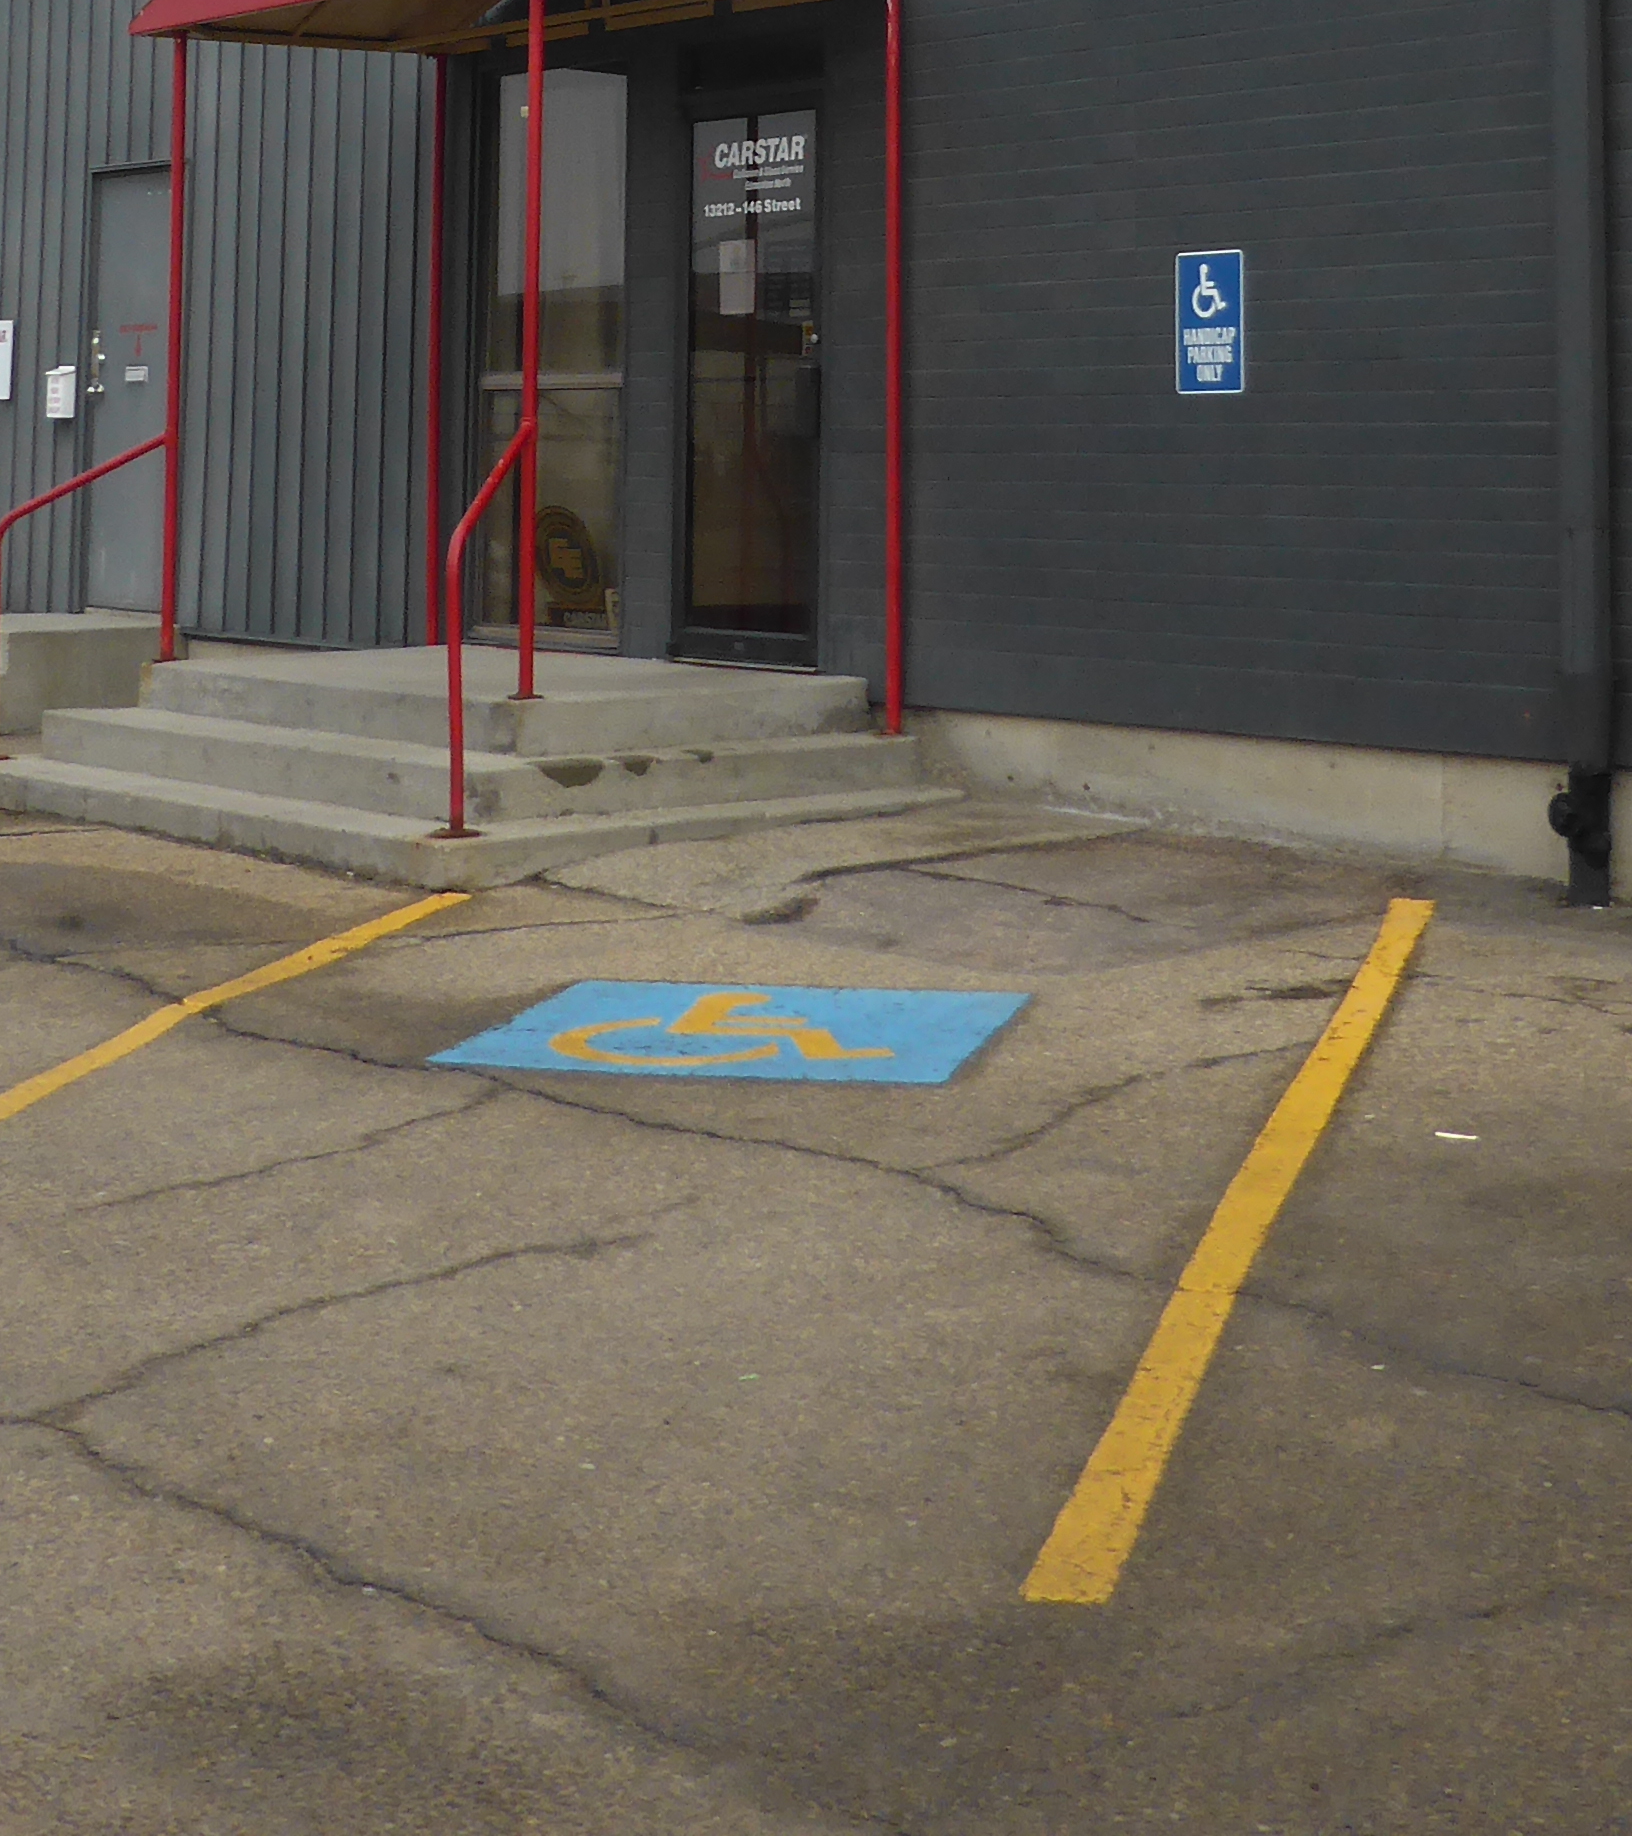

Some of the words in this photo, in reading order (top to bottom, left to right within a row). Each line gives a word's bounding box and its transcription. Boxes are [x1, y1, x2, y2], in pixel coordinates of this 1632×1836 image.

[714, 135, 805, 169] CARSTAR
[764, 197, 801, 213] Street
[1183, 326, 1236, 346] HANDICAP
[1187, 345, 1234, 364] PARKING
[1196, 364, 1223, 382] ONLY
